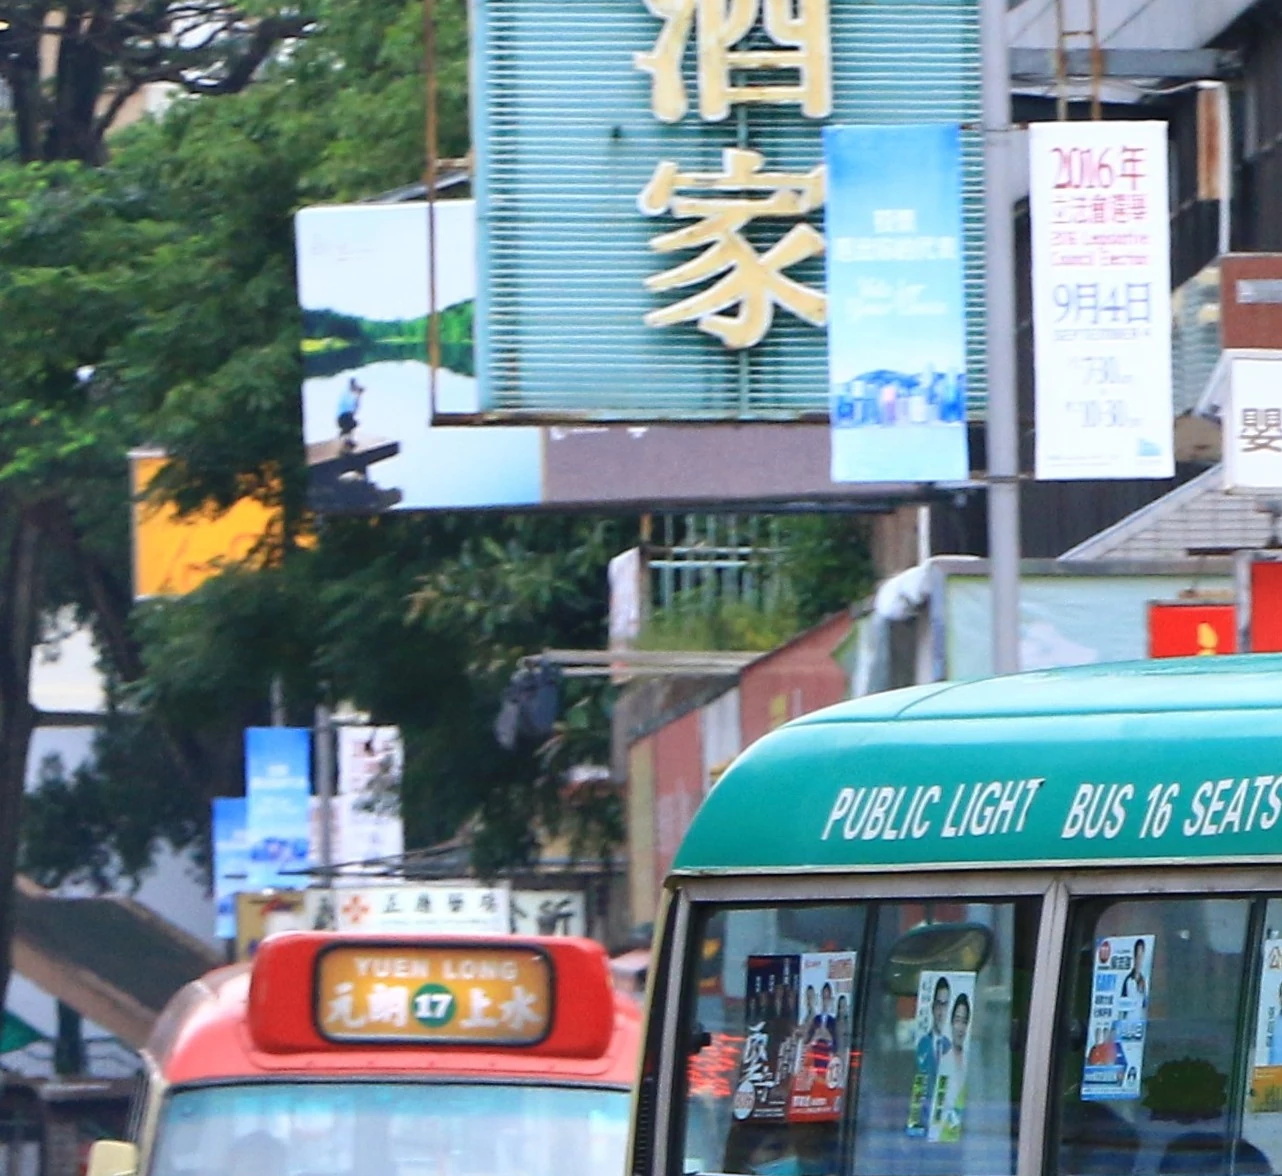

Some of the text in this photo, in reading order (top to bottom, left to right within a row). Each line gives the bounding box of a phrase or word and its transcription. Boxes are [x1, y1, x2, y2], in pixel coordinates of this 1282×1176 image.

[634, 0, 832, 350] 酒家
[1050, 147, 1147, 191] 2016年
[1053, 282, 1151, 325] 9月4日
[821, 786, 942, 842] PUBLIC
[941, 778, 1046, 839] LIGHT
[1061, 783, 1134, 840] BUS
[1139, 782, 1181, 838] 16
[354, 957, 519, 981] YUEN LONG
[326, 980, 541, 1029] 元朗 17 上水
